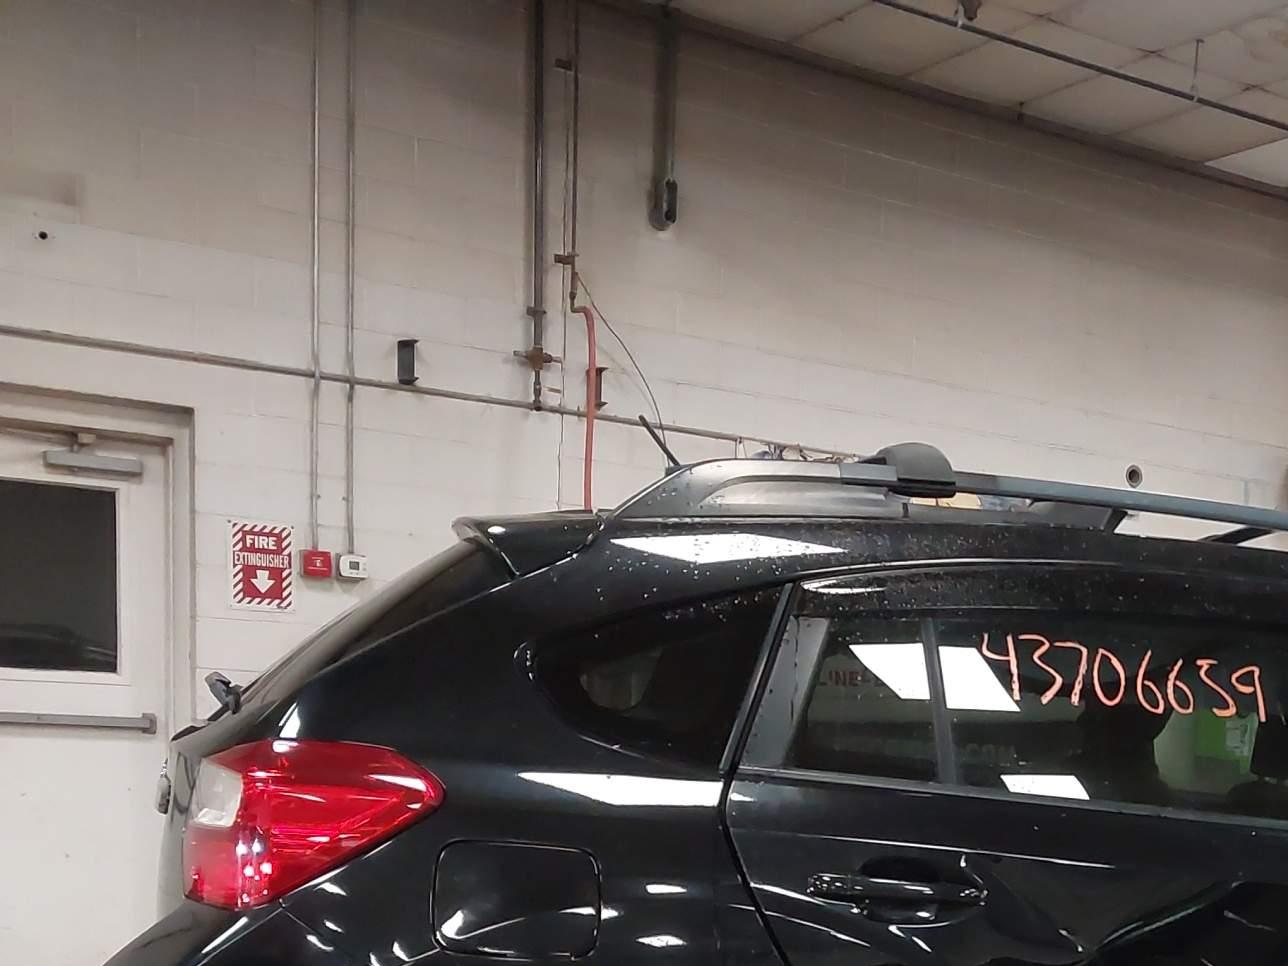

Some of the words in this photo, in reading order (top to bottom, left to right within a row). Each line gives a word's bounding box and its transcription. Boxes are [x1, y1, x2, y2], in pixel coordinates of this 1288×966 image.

[245, 534, 278, 550] FIRE
[234, 551, 290, 569] EXTINGUISHER
[981, 632, 1267, 723] 43706659
